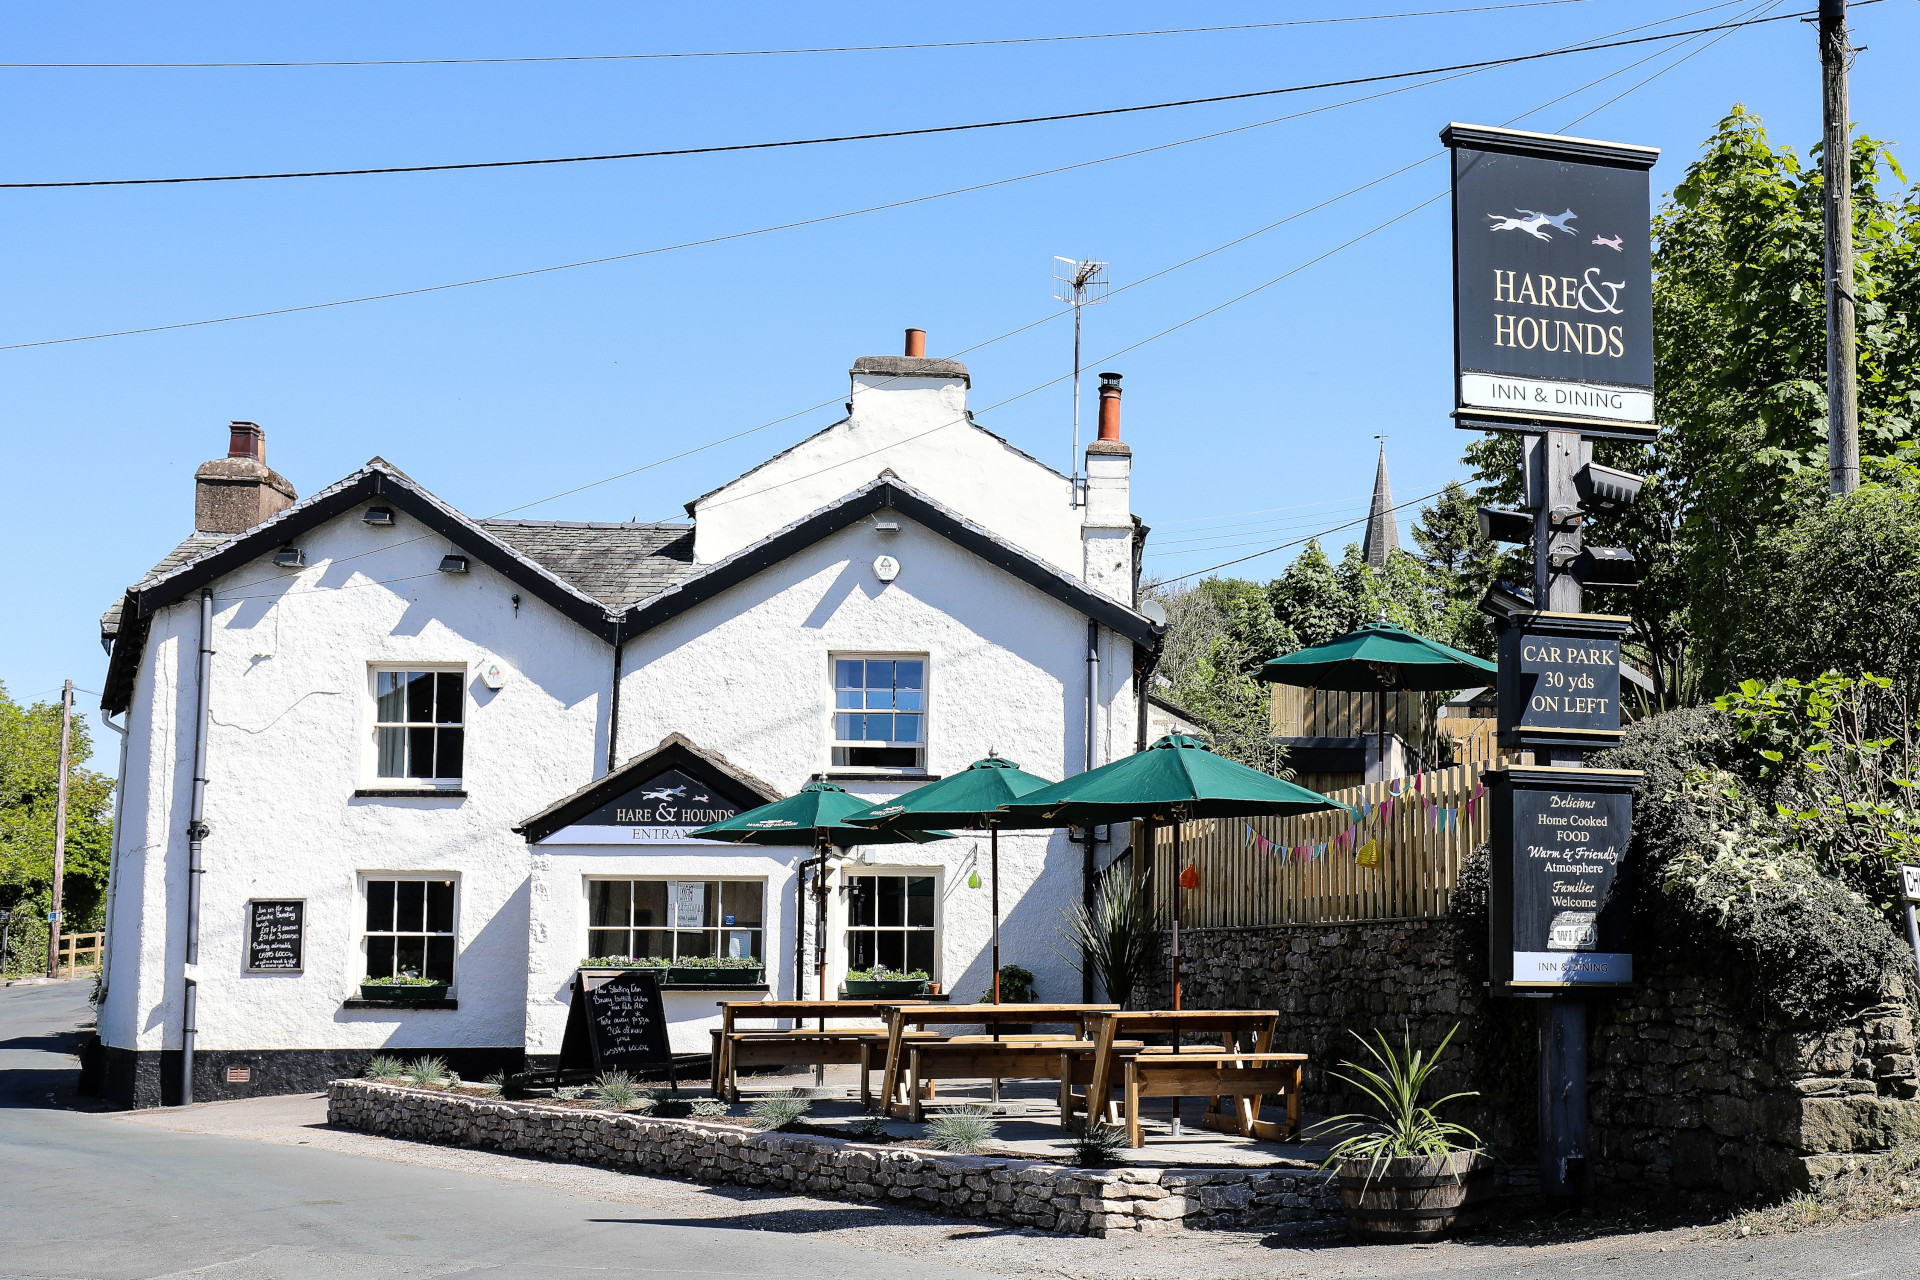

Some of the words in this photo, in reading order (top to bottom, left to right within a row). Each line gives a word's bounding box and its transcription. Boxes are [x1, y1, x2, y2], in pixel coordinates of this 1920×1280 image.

[1493, 314, 1625, 358] HOUNDS
[1492, 383, 1526, 401] INN
[1534, 386, 1548, 404] &
[1555, 388, 1623, 410] DINING
[1523, 645, 1563, 663] CAR
[1566, 647, 1616, 666] PARK
[1545, 671, 1564, 688] 30
[1568, 672, 1595, 692] yds
[1531, 695, 1560, 712] ON
[1563, 696, 1609, 714] LEFT
[1550, 794, 1596, 809] Delicious
[616, 808, 652, 822] HARE
[655, 802, 678, 822] &
[681, 809, 735, 822] HOUNDS
[1537, 814, 1568, 826] Home
[1570, 815, 1608, 827] Cooked
[632, 828, 702, 840] ENTRAN
[1556, 830, 1590, 842] FOOD
[1527, 845, 1560, 859] Warm
[1562, 848, 1574, 862] &
[1574, 845, 1619, 865] Friendly
[1544, 861, 1603, 876] Atmosphere
[1552, 879, 1595, 893] Families
[1906, 870, 1920, 893] CH
[1551, 896, 1597, 908] Welcome
[1561, 910, 1587, 923] Free
[1538, 962, 1557, 971] INN
[1560, 962, 1569, 972] &
[1571, 963, 1608, 972] DINING
